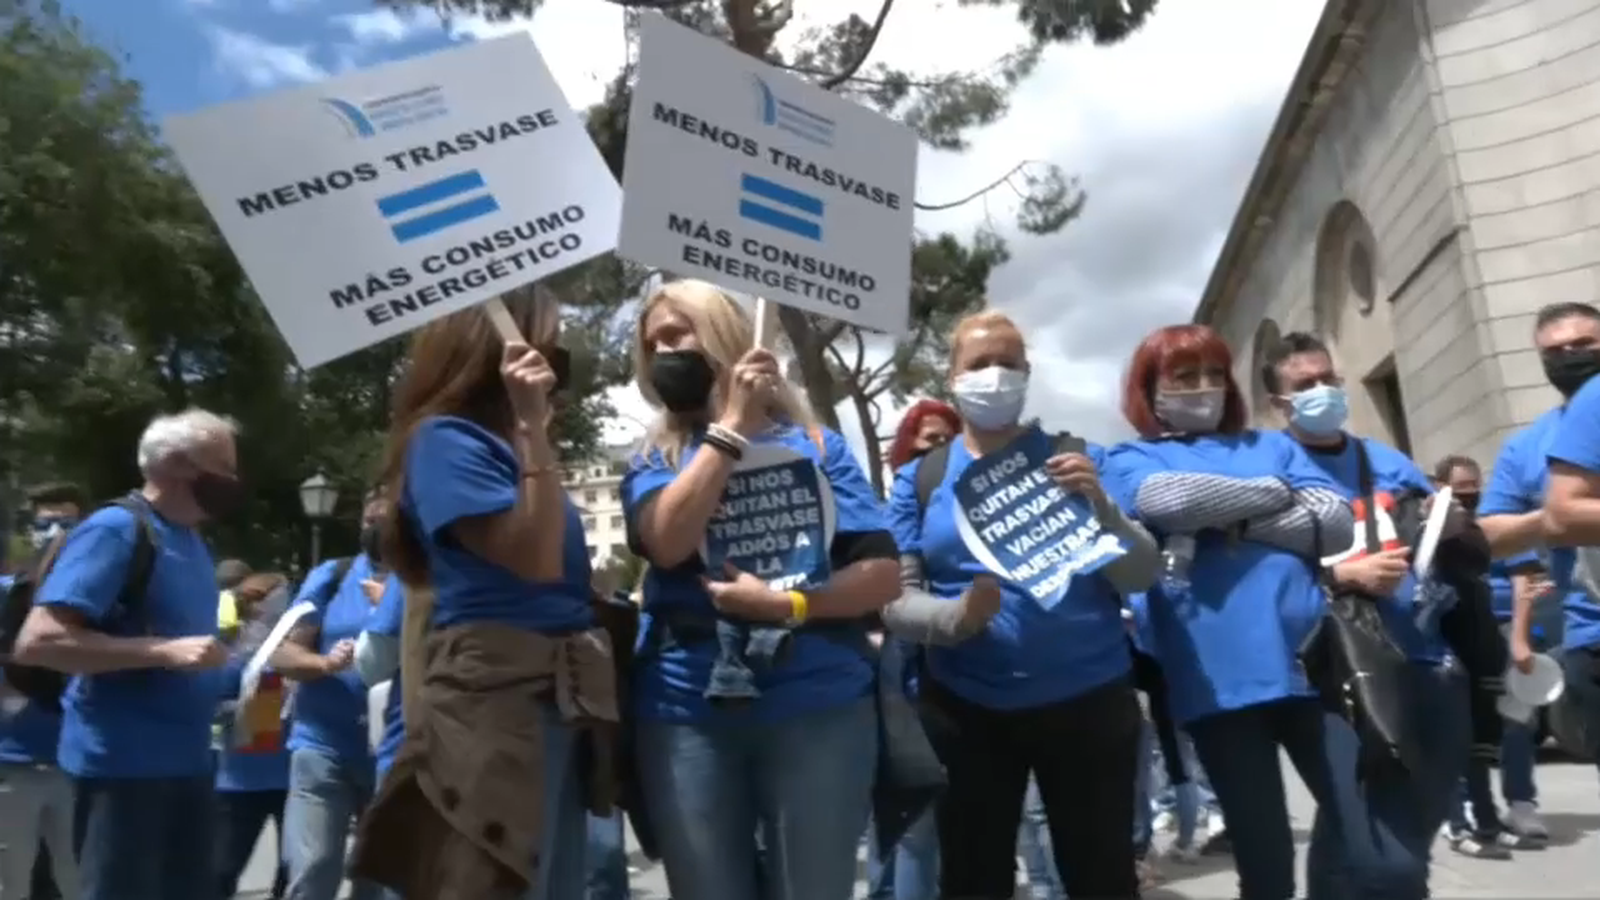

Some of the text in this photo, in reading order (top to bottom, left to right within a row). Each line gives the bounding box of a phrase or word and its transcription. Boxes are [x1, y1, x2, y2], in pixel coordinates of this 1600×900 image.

[237, 108, 558, 216] MENOS TRASVASE
[653, 102, 758, 157] MENOS
[768, 147, 900, 210] TRASVASE
[329, 205, 585, 308] MÁS CONSUMO
[364, 233, 582, 326] ENERGÉTICO
[668, 213, 875, 292] MÁS CONSUMO
[682, 245, 860, 310] ENERGÉTICO
[728, 469, 794, 495] SI NOS
[791, 488, 816, 504] EL
[969, 466, 1048, 522] QUITAN E
[970, 451, 1028, 493] SI NOS
[710, 507, 819, 538] TRASVASE
[727, 531, 811, 556] ADIÓS A
[756, 557, 783, 573] LA
